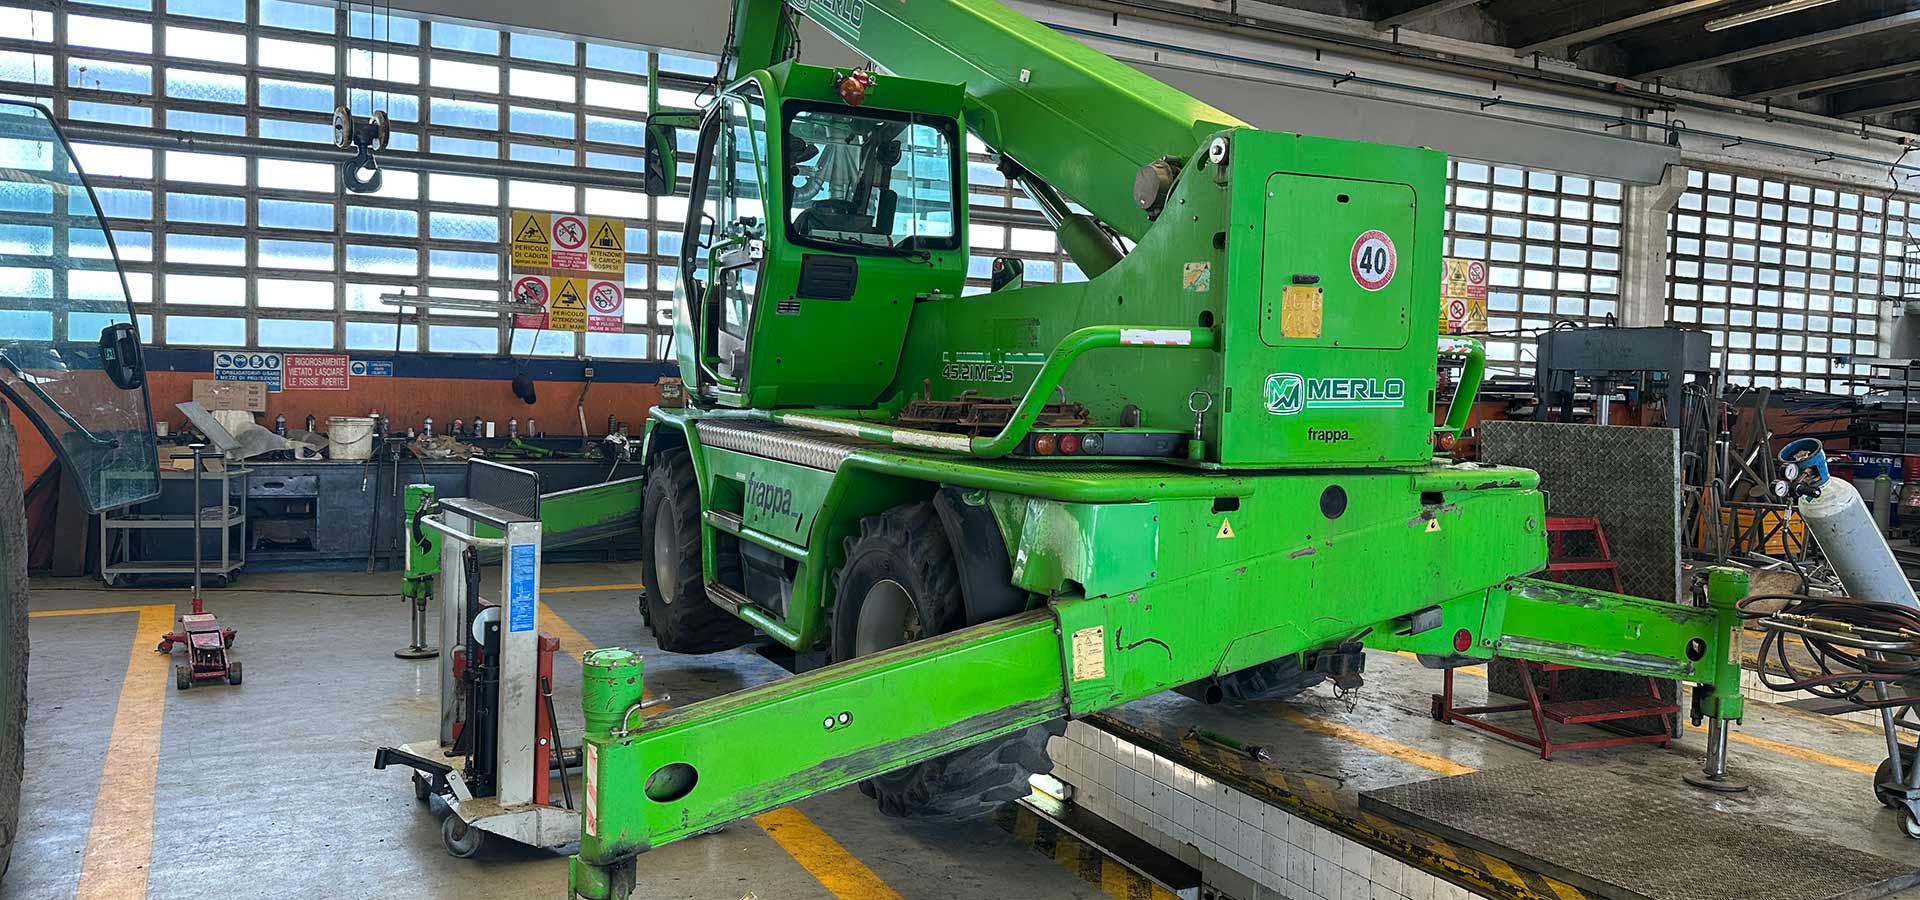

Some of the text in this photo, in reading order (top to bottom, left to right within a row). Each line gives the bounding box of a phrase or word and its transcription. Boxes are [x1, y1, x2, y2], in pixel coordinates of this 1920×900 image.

[514, 244, 549, 252] PERICOLO
[1360, 246, 1386, 275] 40
[295, 358, 346, 366] RIGOROSAMENTE
[288, 368, 344, 376] VIETATO LASCIARE
[288, 378, 297, 386] LE
[299, 378, 319, 386] FOSSE
[321, 378, 345, 386] APERTE
[1307, 378, 1404, 399] MERLO
[1859, 456, 1892, 464] IVECO
